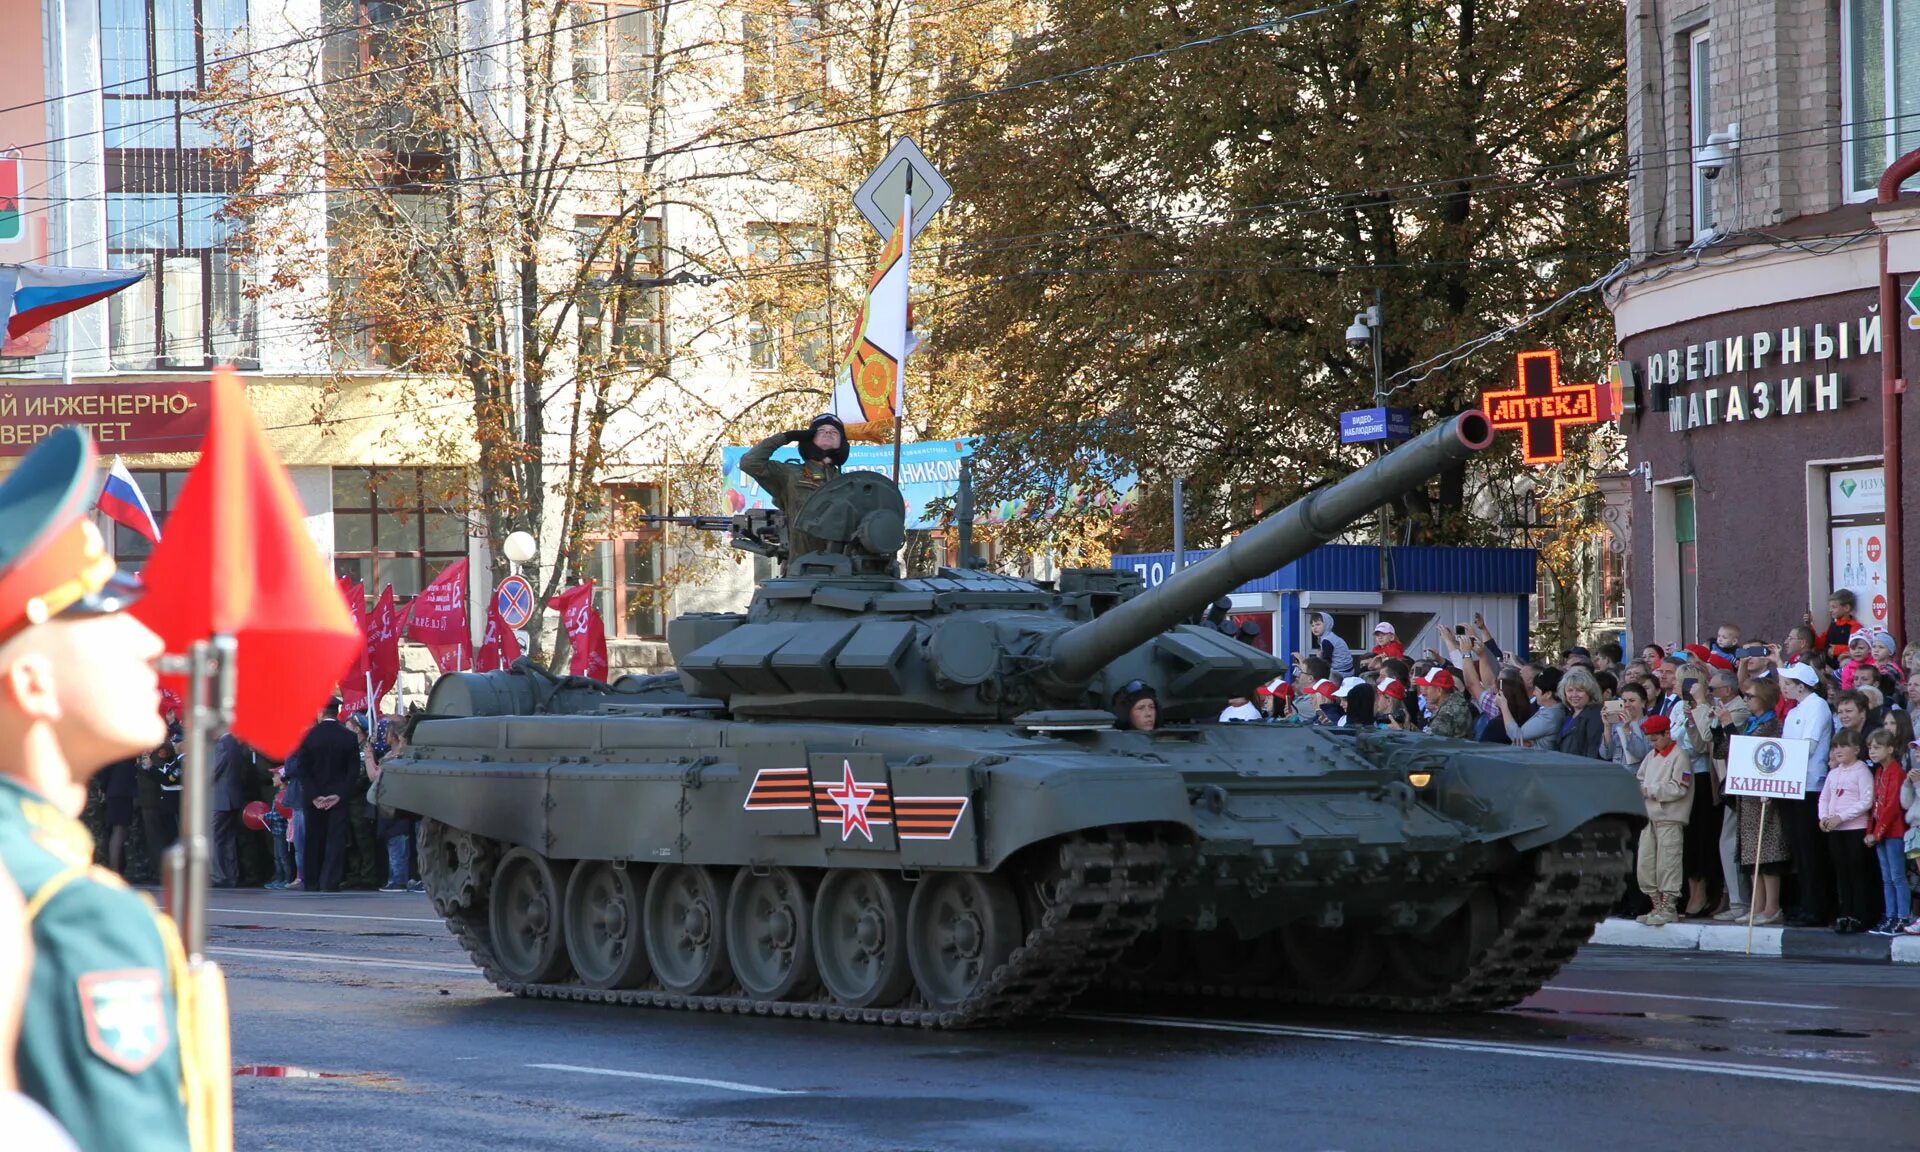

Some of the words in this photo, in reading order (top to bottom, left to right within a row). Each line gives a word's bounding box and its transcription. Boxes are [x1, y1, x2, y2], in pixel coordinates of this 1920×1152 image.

[1648, 303, 1882, 390] ЮВЕЛИРНЫЙ
[25, 391, 198, 417] ИНЖЕНЕРНО-
[1493, 393, 1588, 421] АПТЕКА
[1669, 372, 1838, 433] МАГАЗИН
[1344, 424, 1383, 436] НАБЛЮДЕНИЕ
[1352, 415, 1374, 425] ВИДЕО-
[0, 422, 131, 445] ВЕРТЕТ
[1729, 776, 1802, 797] КЛИНЦЫ
